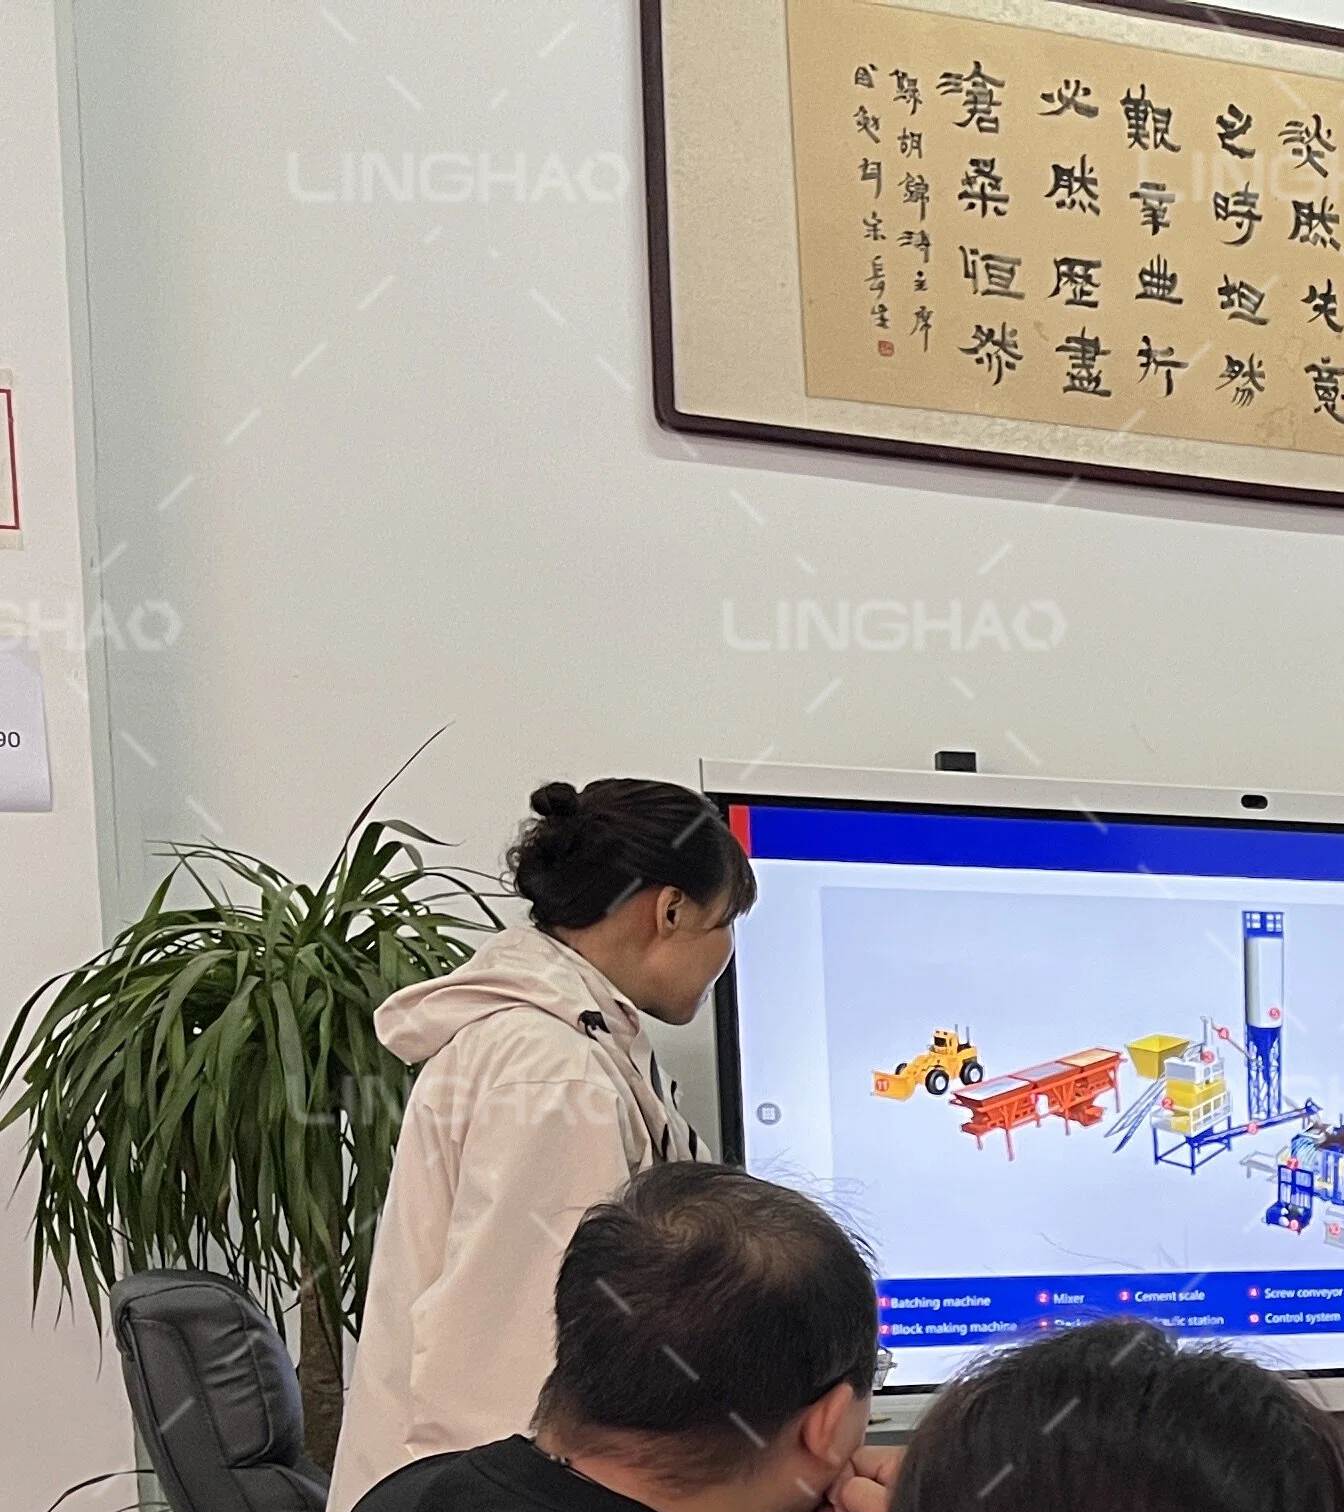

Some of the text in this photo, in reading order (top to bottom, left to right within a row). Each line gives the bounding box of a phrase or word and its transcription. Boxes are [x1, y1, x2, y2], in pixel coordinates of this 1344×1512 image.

[1053, 1292, 1085, 1304] Mixer
[1134, 1291, 1175, 1302] Cement
[1178, 1289, 1205, 1301] scale
[1264, 1287, 1295, 1298] Screw
[1297, 1286, 1343, 1299] conveyor
[891, 1297, 940, 1311] Batching
[943, 1295, 991, 1306] machine
[1187, 1314, 1225, 1327] station
[1264, 1311, 1303, 1324] Control
[1305, 1311, 1341, 1325] system
[892, 1323, 925, 1335] Block
[926, 1322, 967, 1337] making
[970, 1320, 1018, 1333] machine
